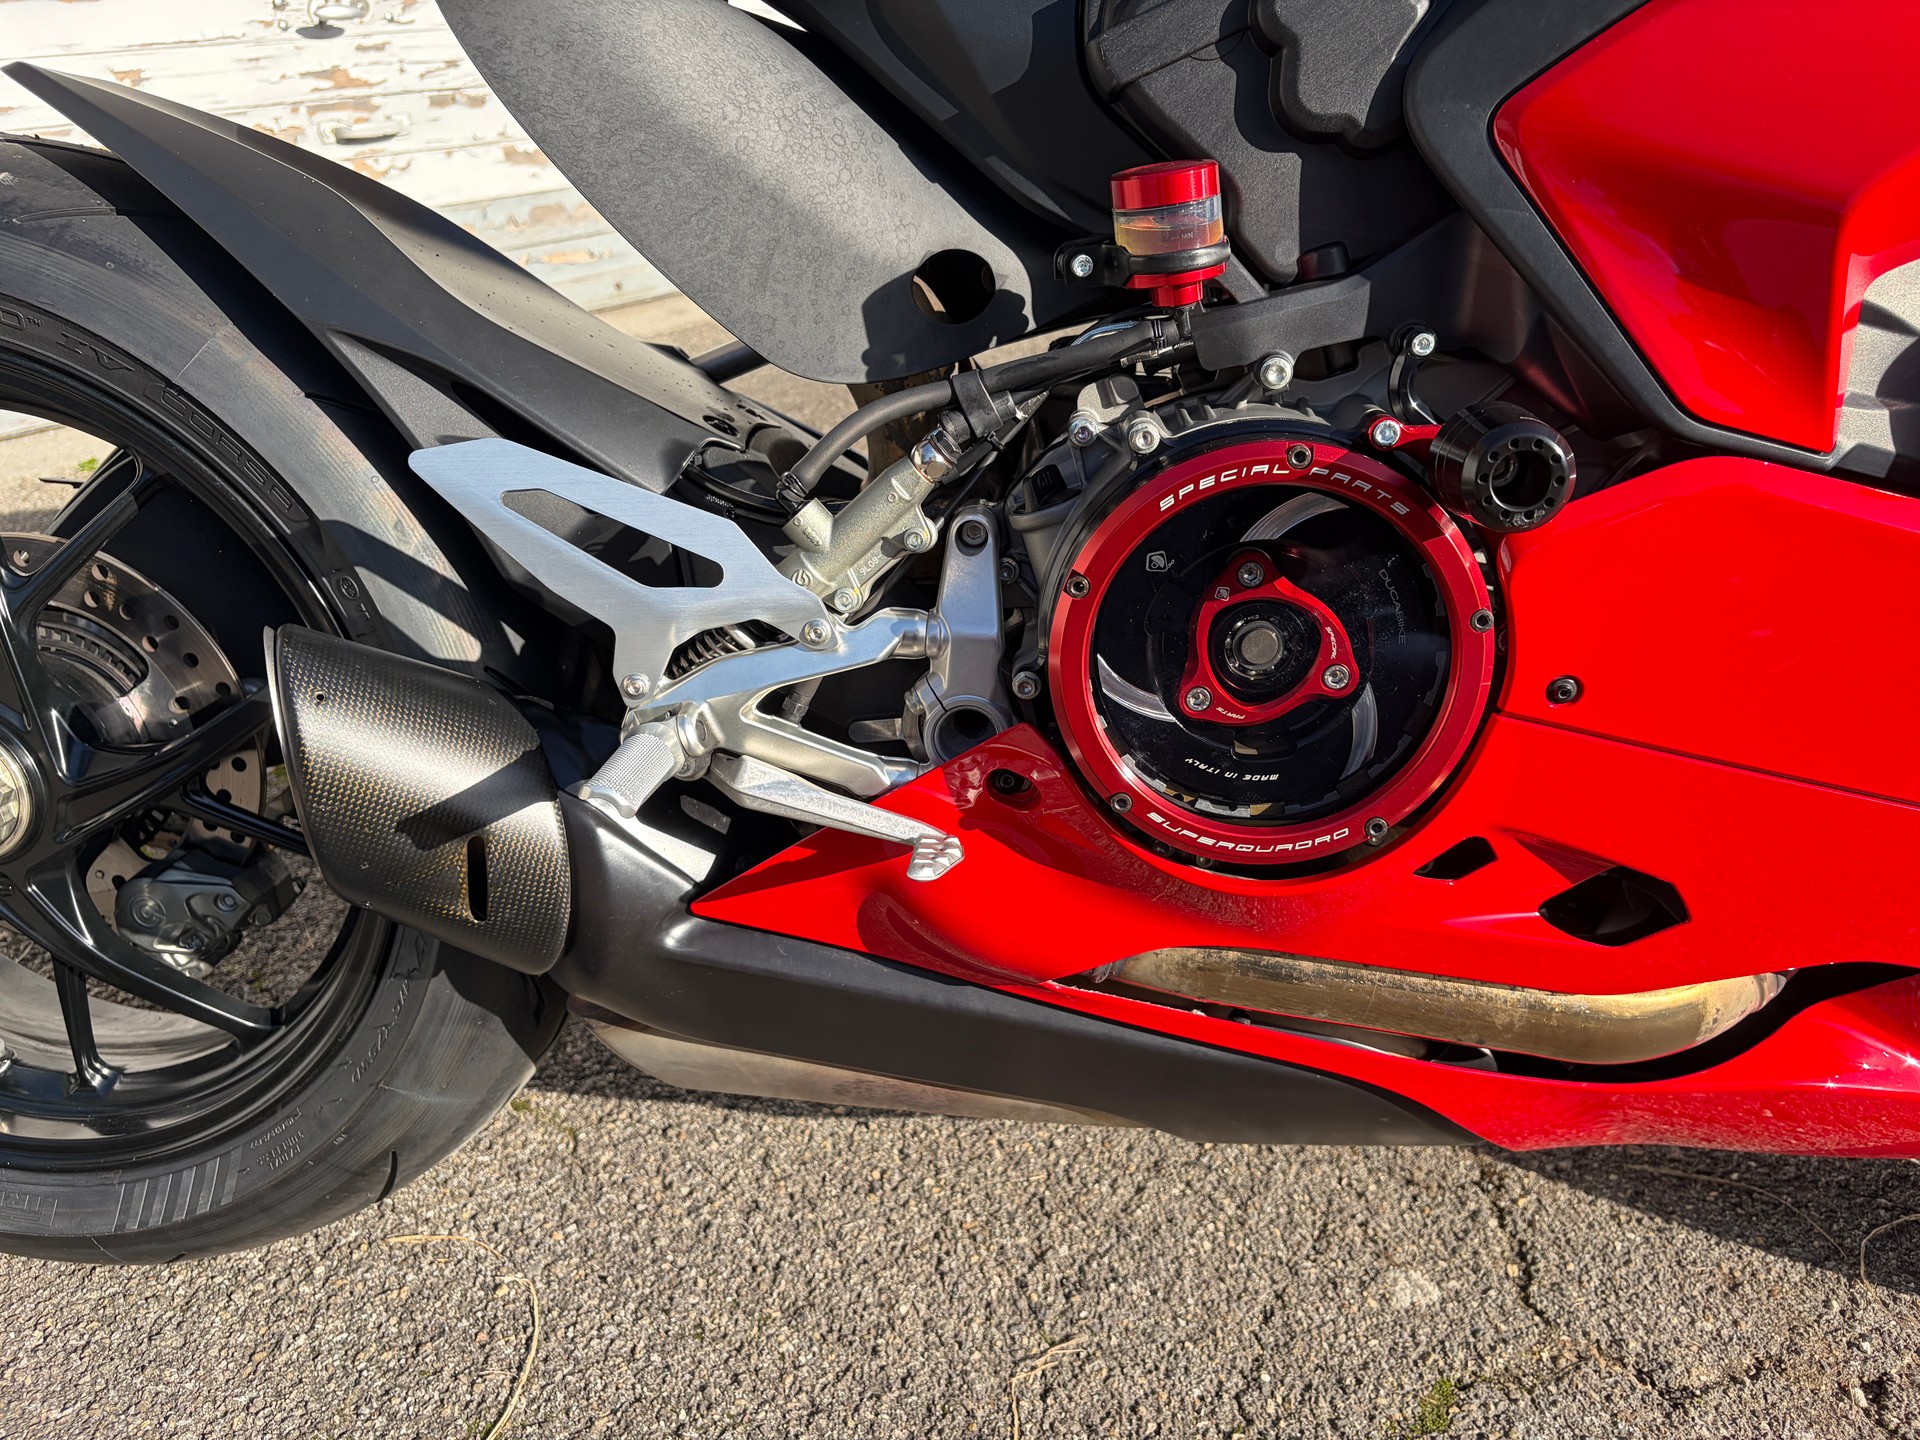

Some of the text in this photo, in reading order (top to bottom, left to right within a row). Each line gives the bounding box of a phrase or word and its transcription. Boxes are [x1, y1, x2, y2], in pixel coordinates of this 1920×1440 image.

[161, 385, 293, 512] CORSA
[1159, 464, 1411, 515] SPECIAL PARTS
[1378, 568, 1407, 645] DUCABIKE
[1324, 626, 1338, 660] SPECIAL
[1215, 706, 1246, 720] PARTS
[1184, 758, 1280, 781] MADE IN ITALY
[1146, 811, 1349, 853] SUPERQUADRO
